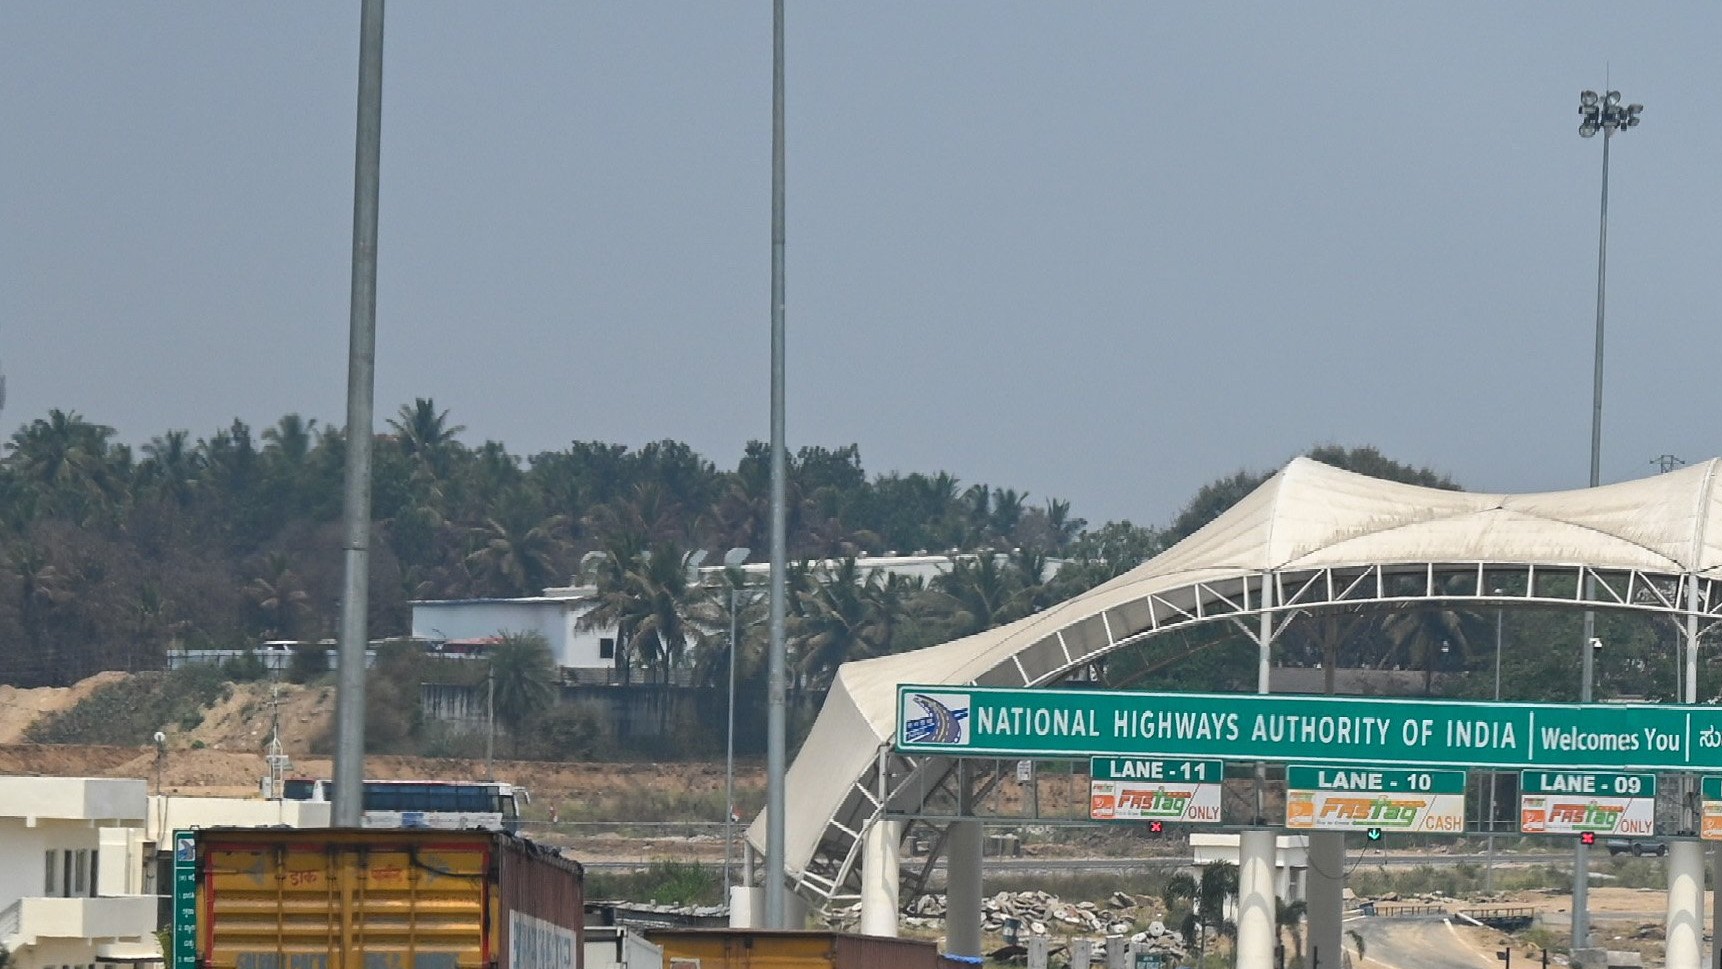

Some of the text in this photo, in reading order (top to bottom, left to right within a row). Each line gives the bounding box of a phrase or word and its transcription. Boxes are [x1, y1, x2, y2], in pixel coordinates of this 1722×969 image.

[977, 706, 1517, 749] NATIONAL HIGHWAYS AUTHORITY OF INDIA
[1541, 725, 1680, 752] Welcomes You
[1110, 760, 1163, 778] LANE
[1180, 762, 1205, 780] 11
[1318, 771, 1383, 790] LANE
[1406, 773, 1432, 790] 10
[1540, 773, 1596, 792] LANE
[1614, 776, 1641, 793] 09
[1188, 806, 1220, 820] ONLY
[1425, 815, 1462, 830] CASH
[1620, 820, 1652, 833] ONLY
